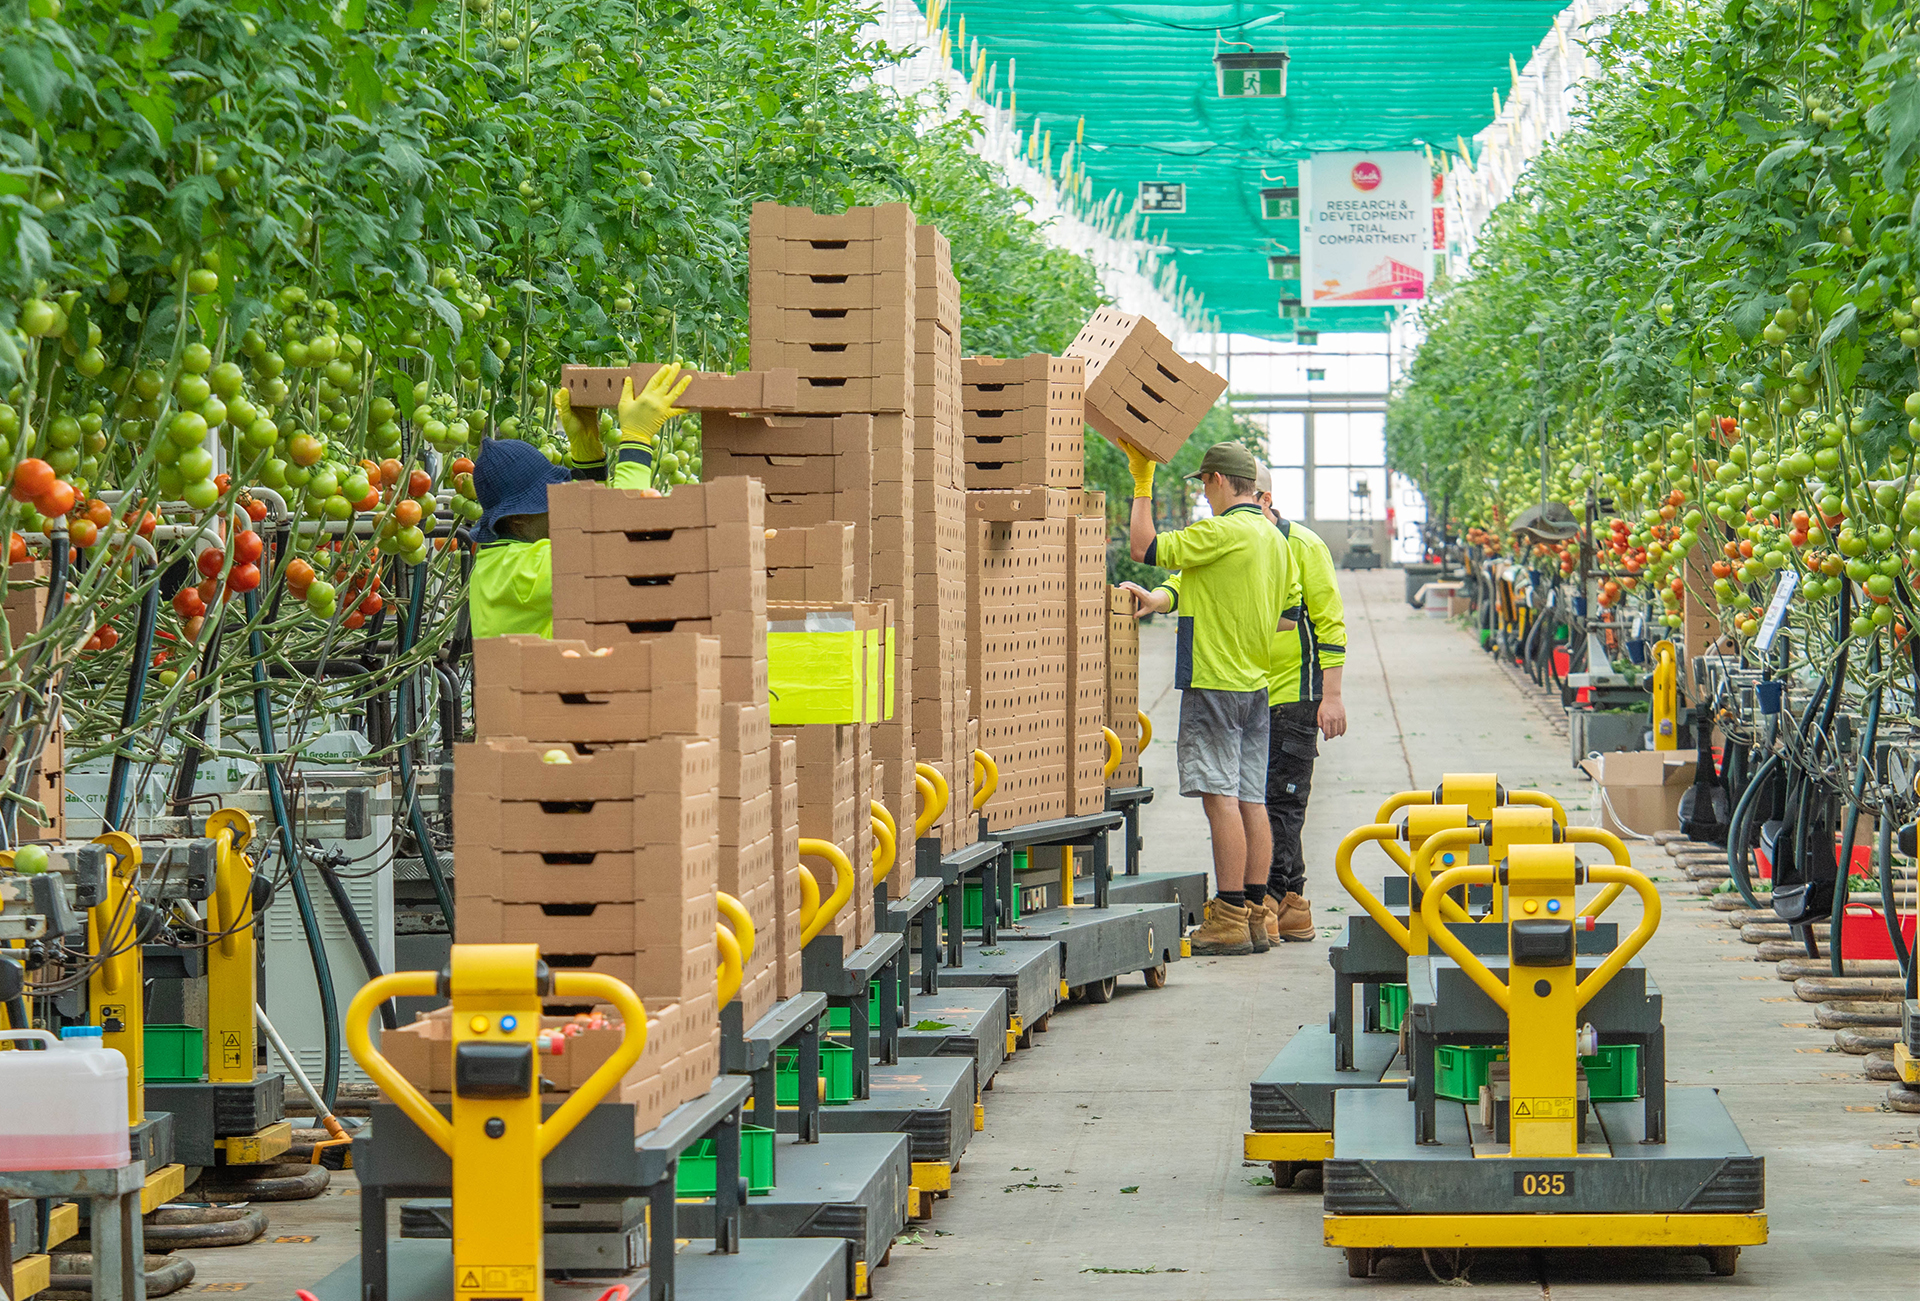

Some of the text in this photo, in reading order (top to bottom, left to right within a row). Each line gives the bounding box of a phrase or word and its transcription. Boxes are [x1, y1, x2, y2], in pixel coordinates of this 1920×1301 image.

[1327, 200, 1408, 210] RESEARCH &
[1320, 210, 1415, 221] DEVELOPMENT
[1349, 223, 1386, 233] TRIAL
[1318, 234, 1417, 245] COMPARTMENT
[86, 794, 98, 803] GT
[1522, 1174, 1566, 1195] 035
